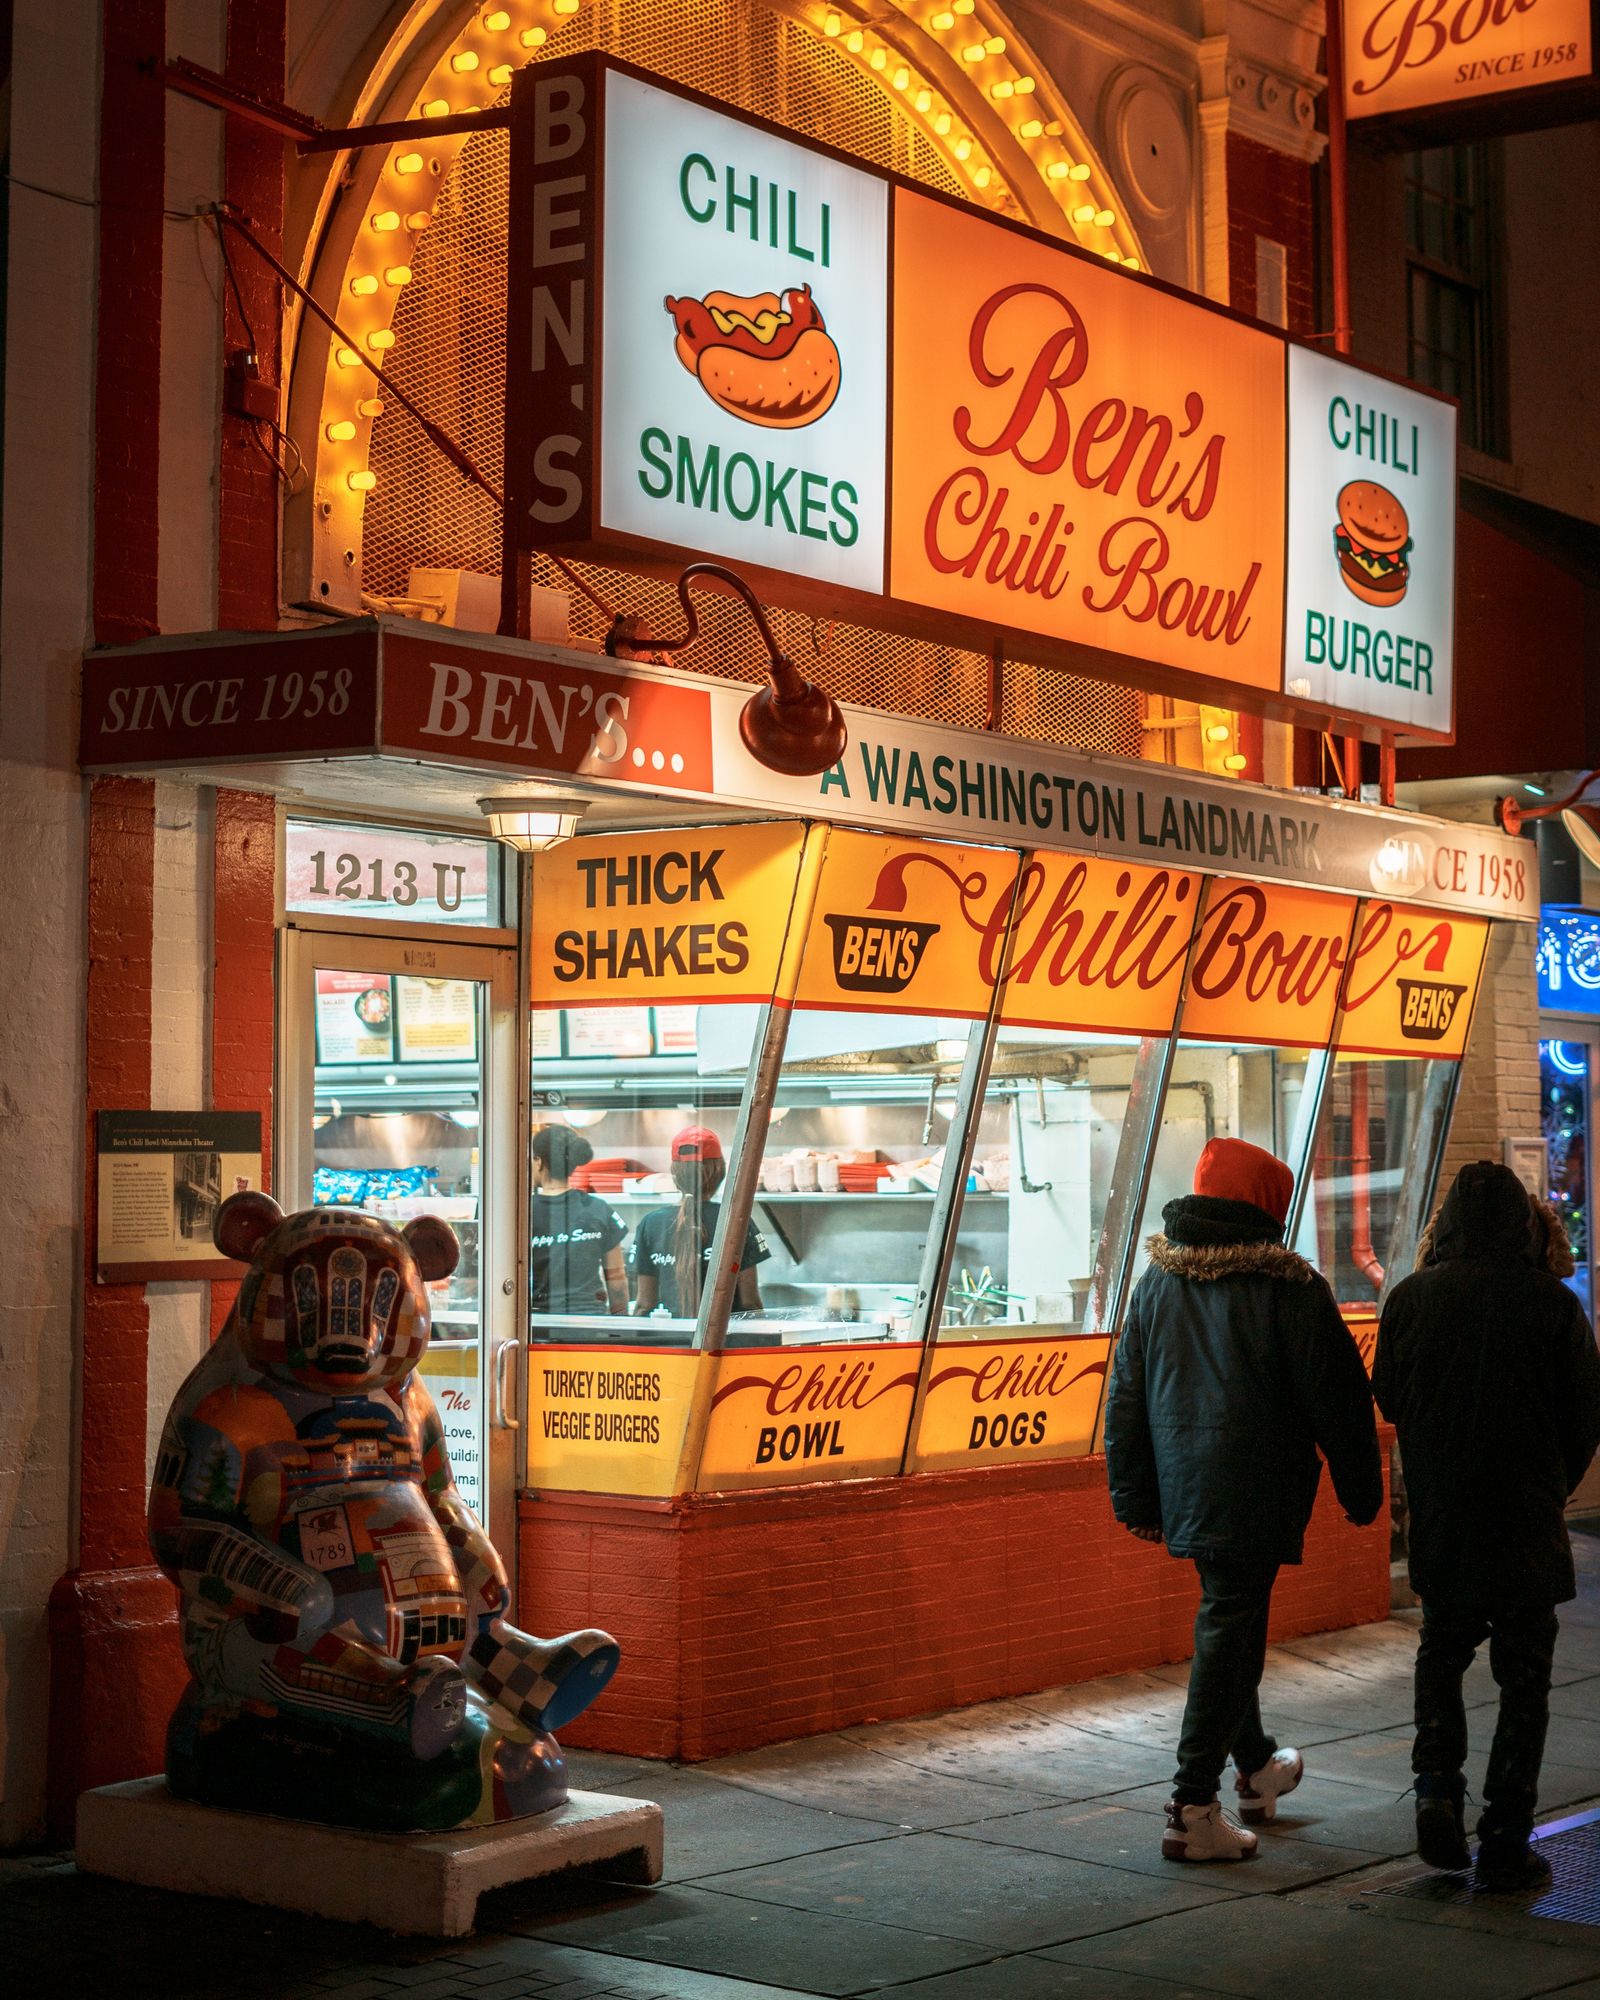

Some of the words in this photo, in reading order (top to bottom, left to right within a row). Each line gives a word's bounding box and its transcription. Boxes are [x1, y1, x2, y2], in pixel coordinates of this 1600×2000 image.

[1455, 52, 1525, 84] SINCE
[1532, 43, 1578, 69] 1958
[679, 152, 830, 268] CHILI
[527, 74, 587, 524] BEN'S
[952, 282, 1226, 522] Ben's
[1328, 396, 1418, 476] CHILI
[637, 426, 860, 548] SMOKES
[924, 466, 1074, 600] Chili
[1082, 516, 1262, 646] Bowl
[1305, 609, 1434, 696] BURGER
[100, 677, 245, 734] SINCE
[255, 667, 353, 722] 1958
[819, 758, 851, 798] A
[860, 741, 1126, 842] WASHINGTON
[1137, 791, 1323, 872] LANDMARK
[1476, 853, 1527, 902] 1958
[309, 850, 418, 906] 1213
[433, 862, 466, 912] U
[577, 849, 726, 909] THICK
[552, 921, 750, 983] SHAKES
[839, 924, 919, 981] BEN'S
[962, 861, 1198, 990] Chili
[1192, 884, 1394, 1013] Bowl
[1402, 986, 1455, 1031] BEN'S
[441, 1390, 471, 1410] The
[543, 1369, 594, 1398] TURKEY
[597, 1372, 661, 1402] BURGERS
[766, 1361, 875, 1417] Chili
[971, 1351, 1069, 1404] Chili
[543, 1411, 591, 1440] VEGGIE
[594, 1413, 660, 1444] BURGERS
[755, 1420, 845, 1465] BOWL
[968, 1411, 1047, 1450] DOGS
[310, 1542, 347, 1565] 1789
